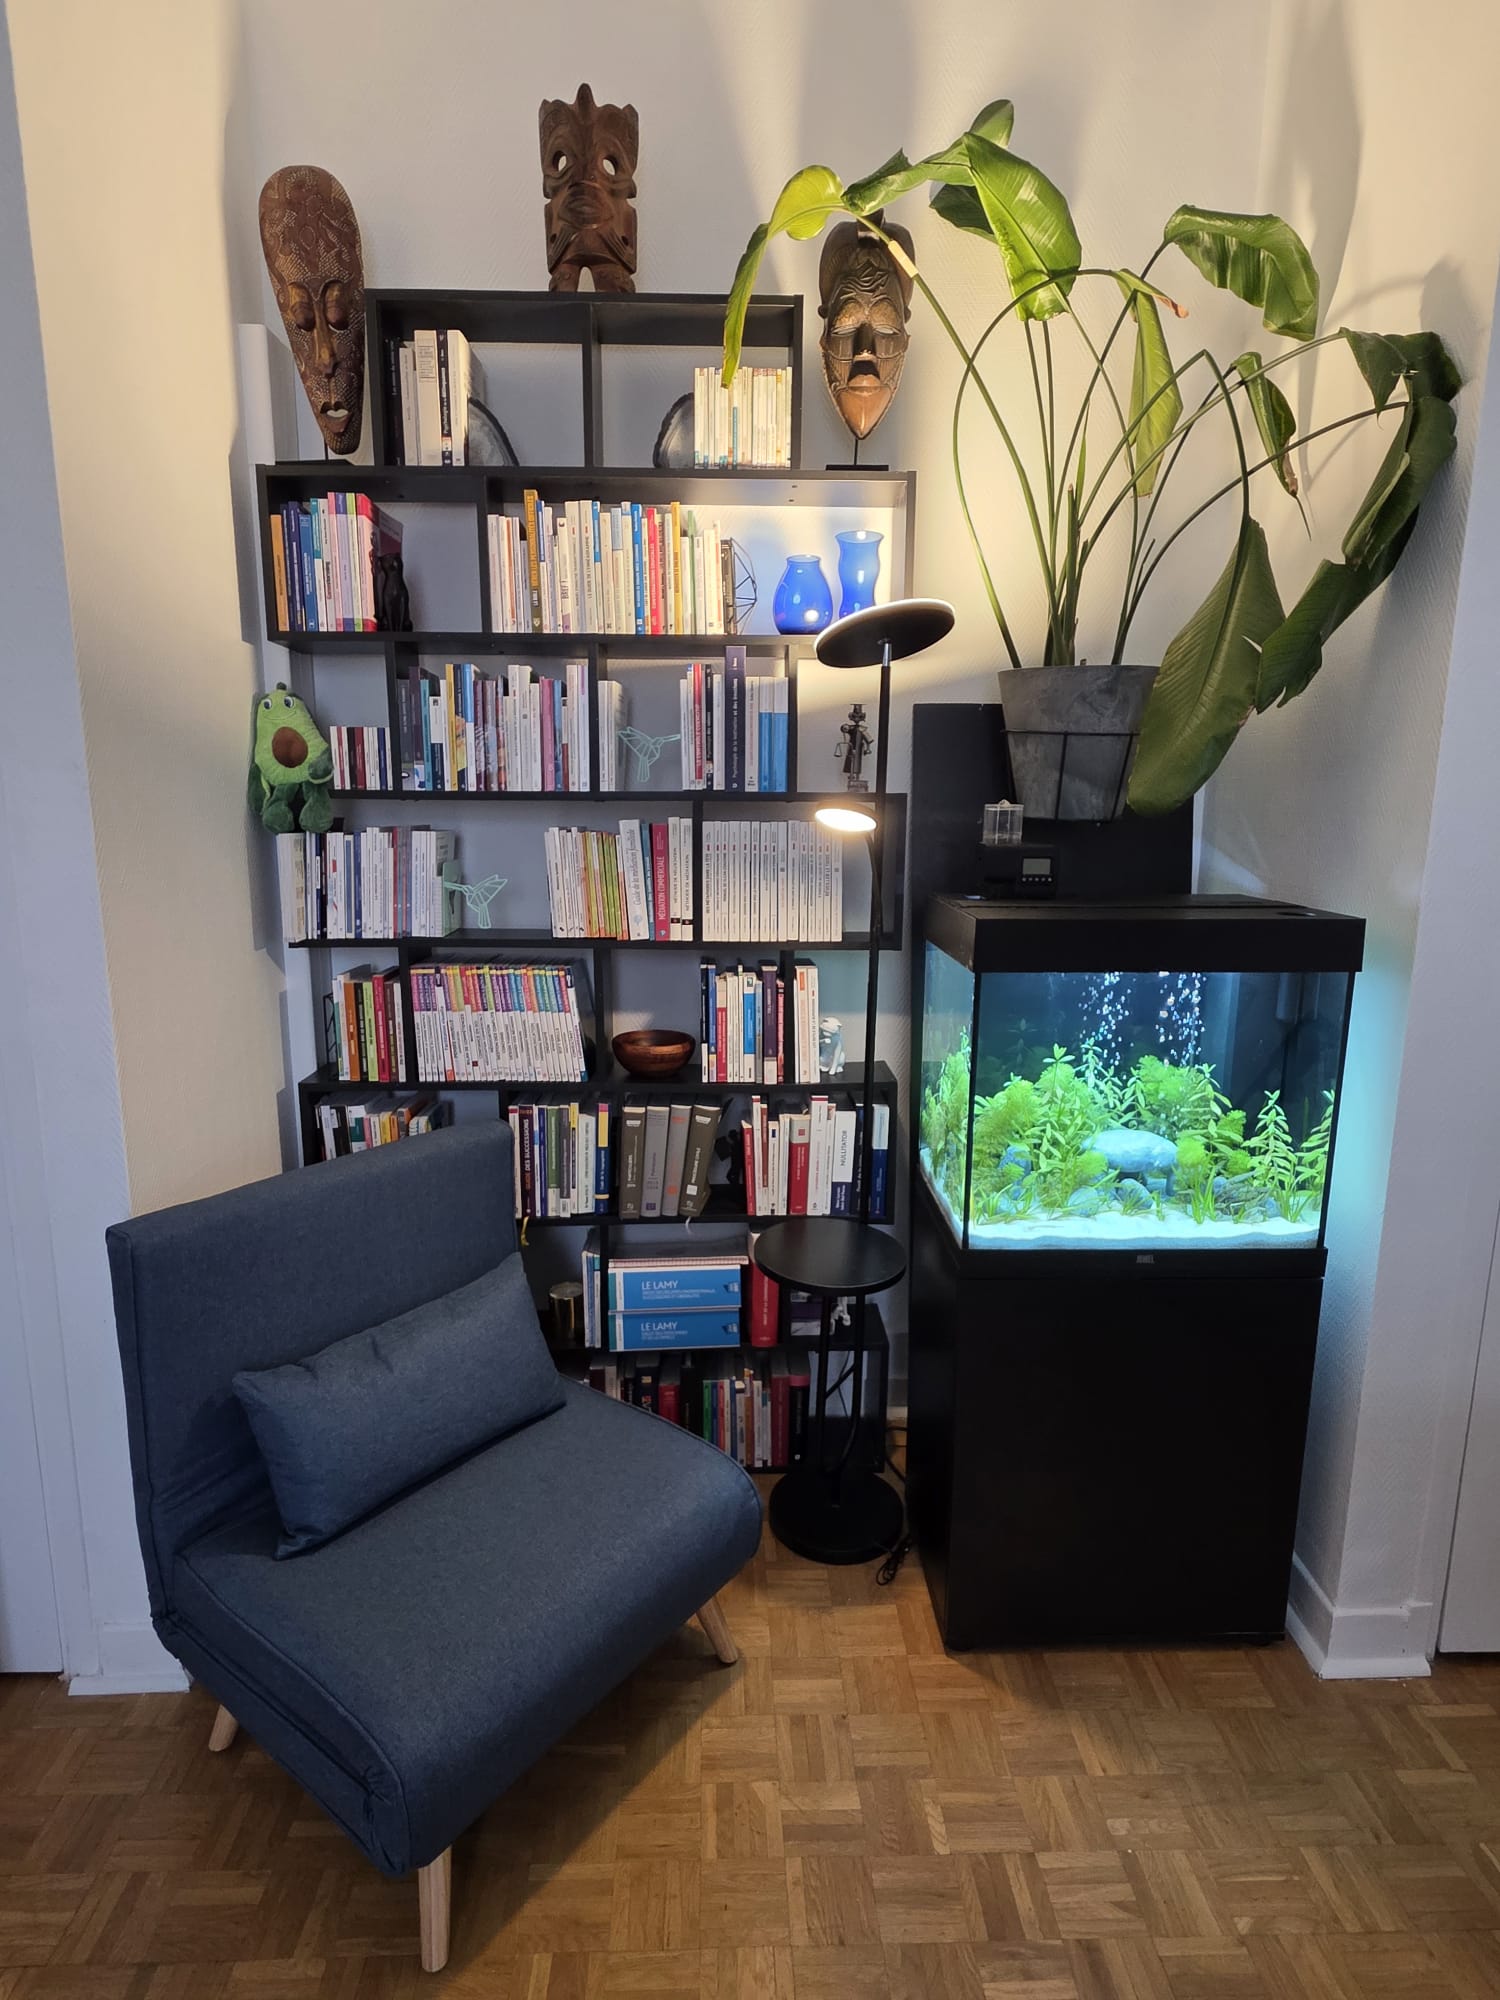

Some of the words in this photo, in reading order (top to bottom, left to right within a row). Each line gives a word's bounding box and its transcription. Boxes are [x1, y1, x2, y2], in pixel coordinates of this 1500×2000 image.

[641, 1281, 650, 1290] LE
[653, 1280, 679, 1289] LAMY
[641, 1323, 650, 1331] LE
[653, 1322, 678, 1331] LAMY
